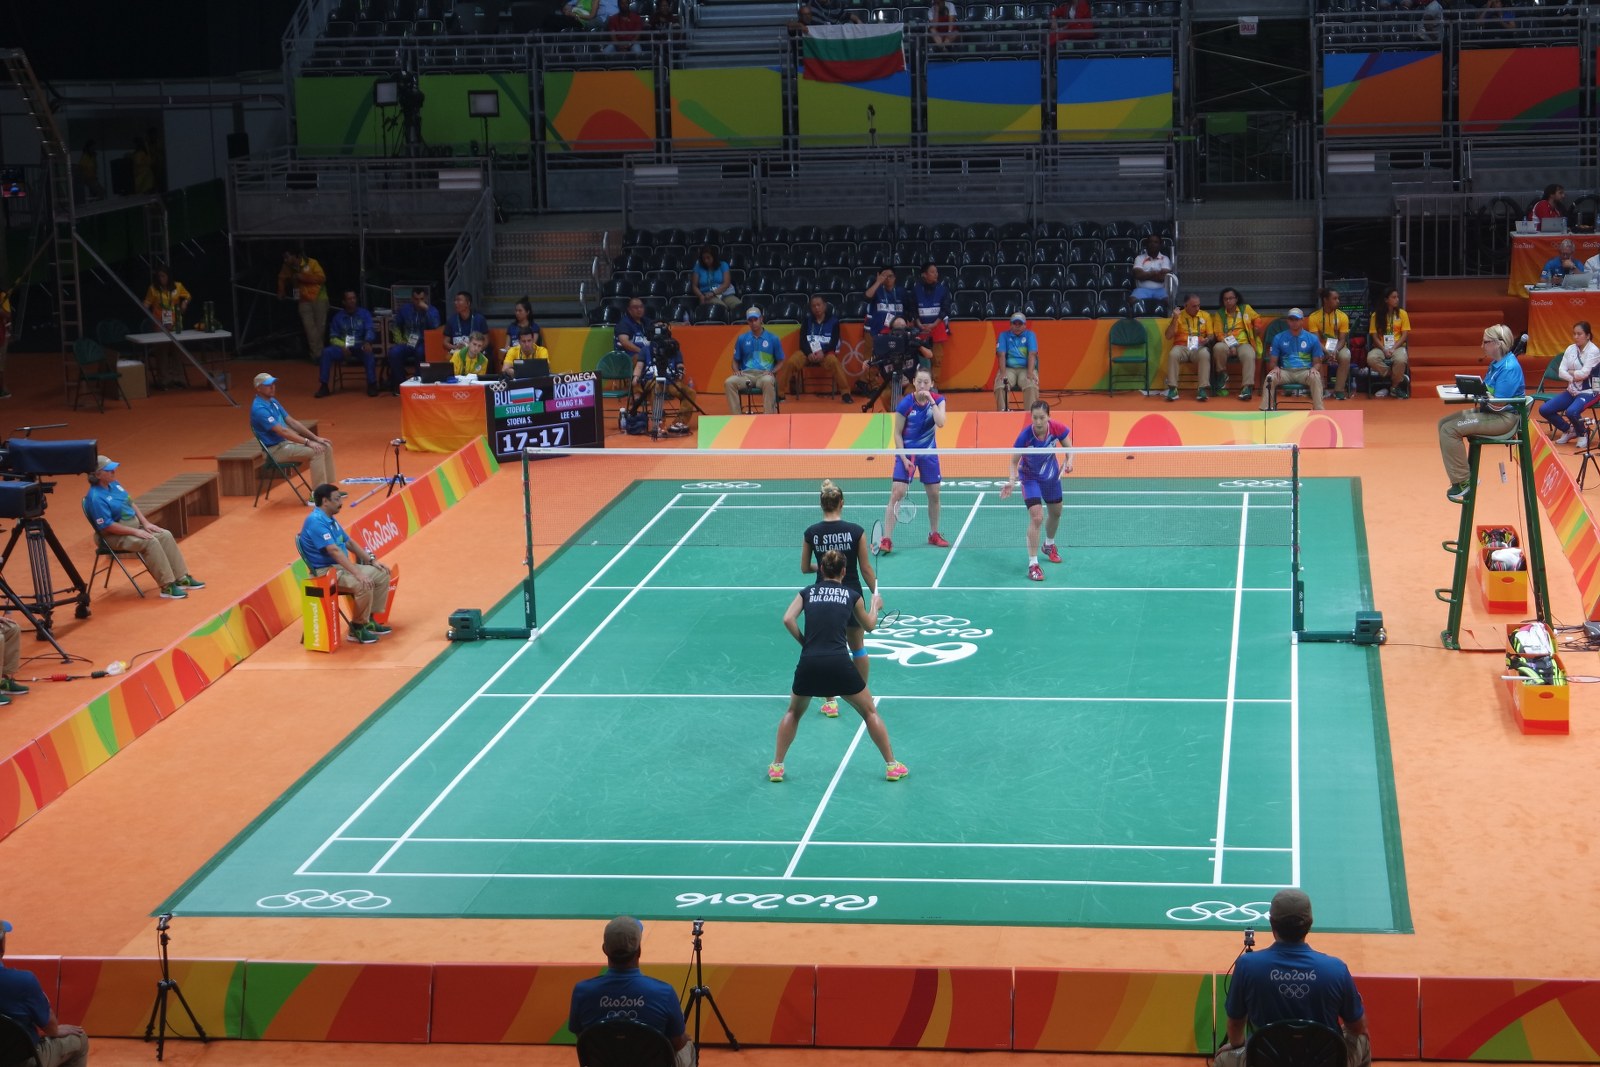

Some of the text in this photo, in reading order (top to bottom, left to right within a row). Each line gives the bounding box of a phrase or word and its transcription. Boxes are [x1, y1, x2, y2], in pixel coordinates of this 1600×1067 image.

[564, 372, 597, 382] OMEGA
[555, 383, 573, 399] KOR
[494, 390, 513, 406] BUL
[555, 400, 574, 408] CHANG
[505, 406, 526, 415] STOEVA
[560, 412, 570, 420] LEE
[506, 417, 526, 427] STOEVA
[502, 427, 565, 453] 17-17
[813, 532, 852, 545] G STOEVA
[816, 543, 851, 551] BULGARIA
[809, 587, 849, 598] S STOEVA
[809, 594, 847, 604] BULGARIA
[864, 628, 993, 638] Rio20
[675, 892, 878, 911] Rio2016
[1270, 968, 1317, 981] Rio2016
[600, 995, 645, 1008] Rio2016
